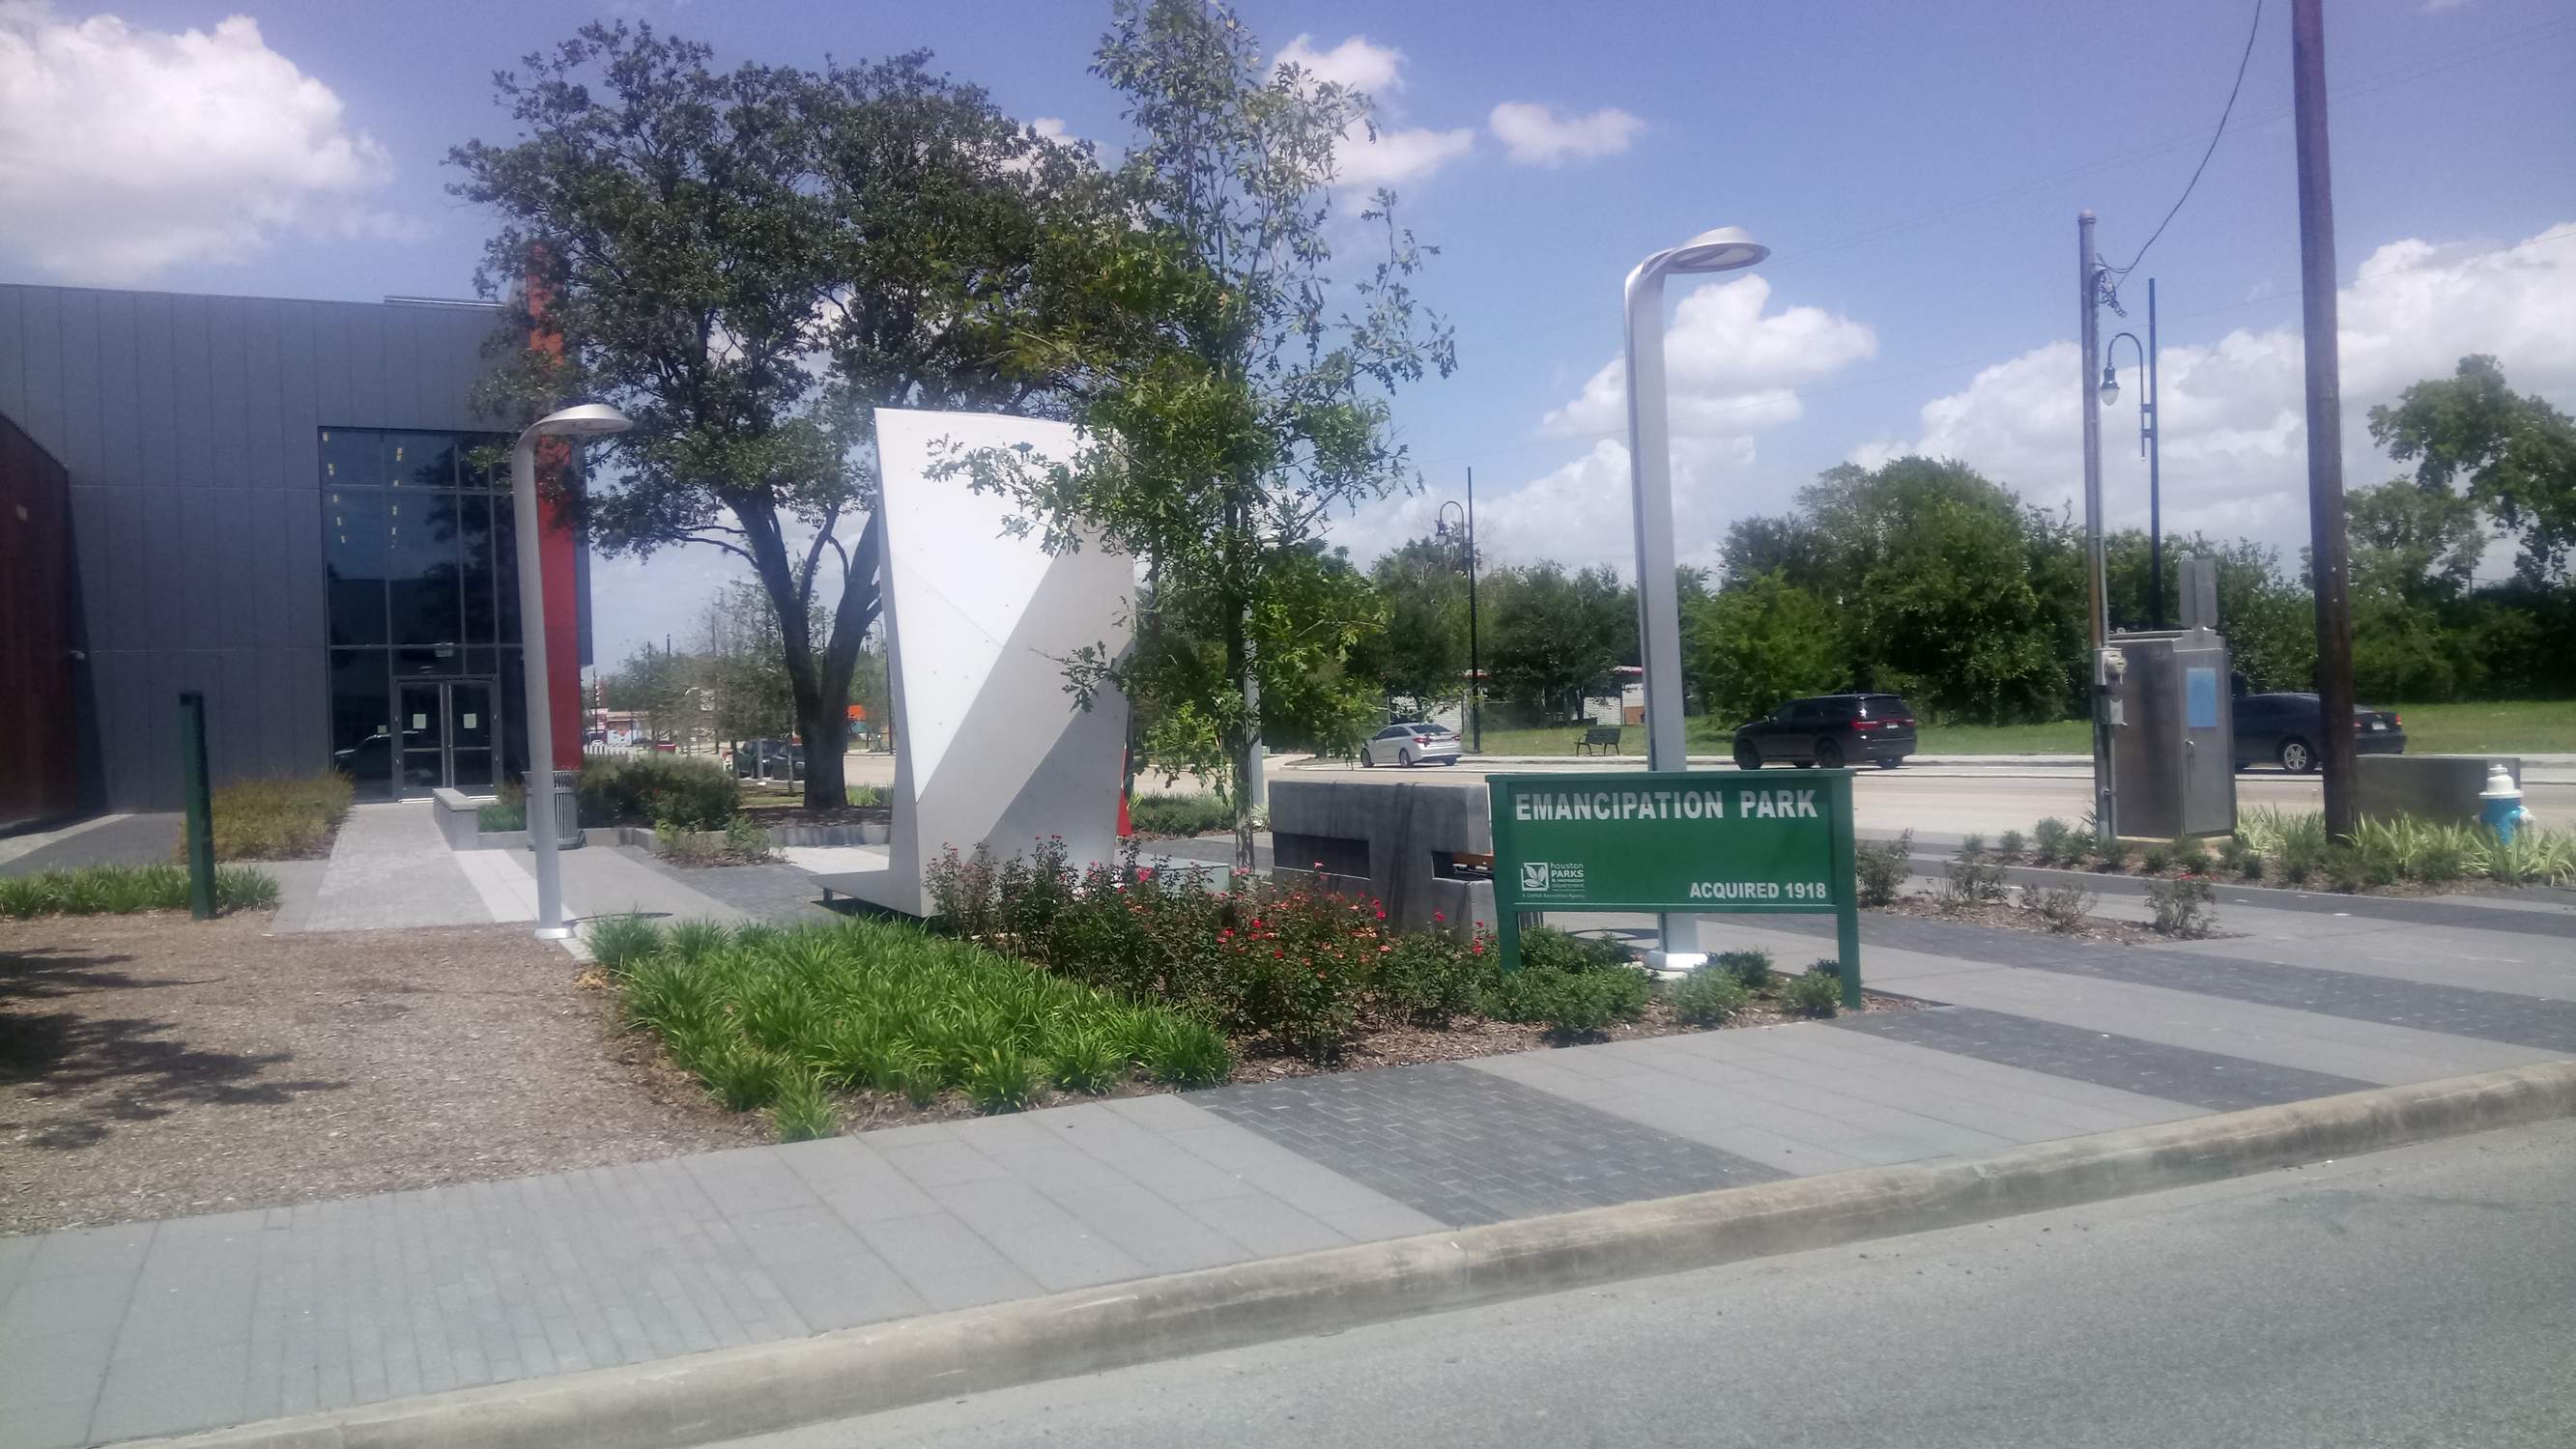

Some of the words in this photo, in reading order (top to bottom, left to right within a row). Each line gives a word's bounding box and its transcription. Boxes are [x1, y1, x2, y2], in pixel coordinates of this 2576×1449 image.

[1516, 791, 1724, 820] EMANCIPATION
[1740, 789, 1818, 818] PARK
[1551, 869, 1585, 878] PARKS
[1690, 882, 1780, 899] ACQUIRED
[1785, 882, 1826, 898] 1918
